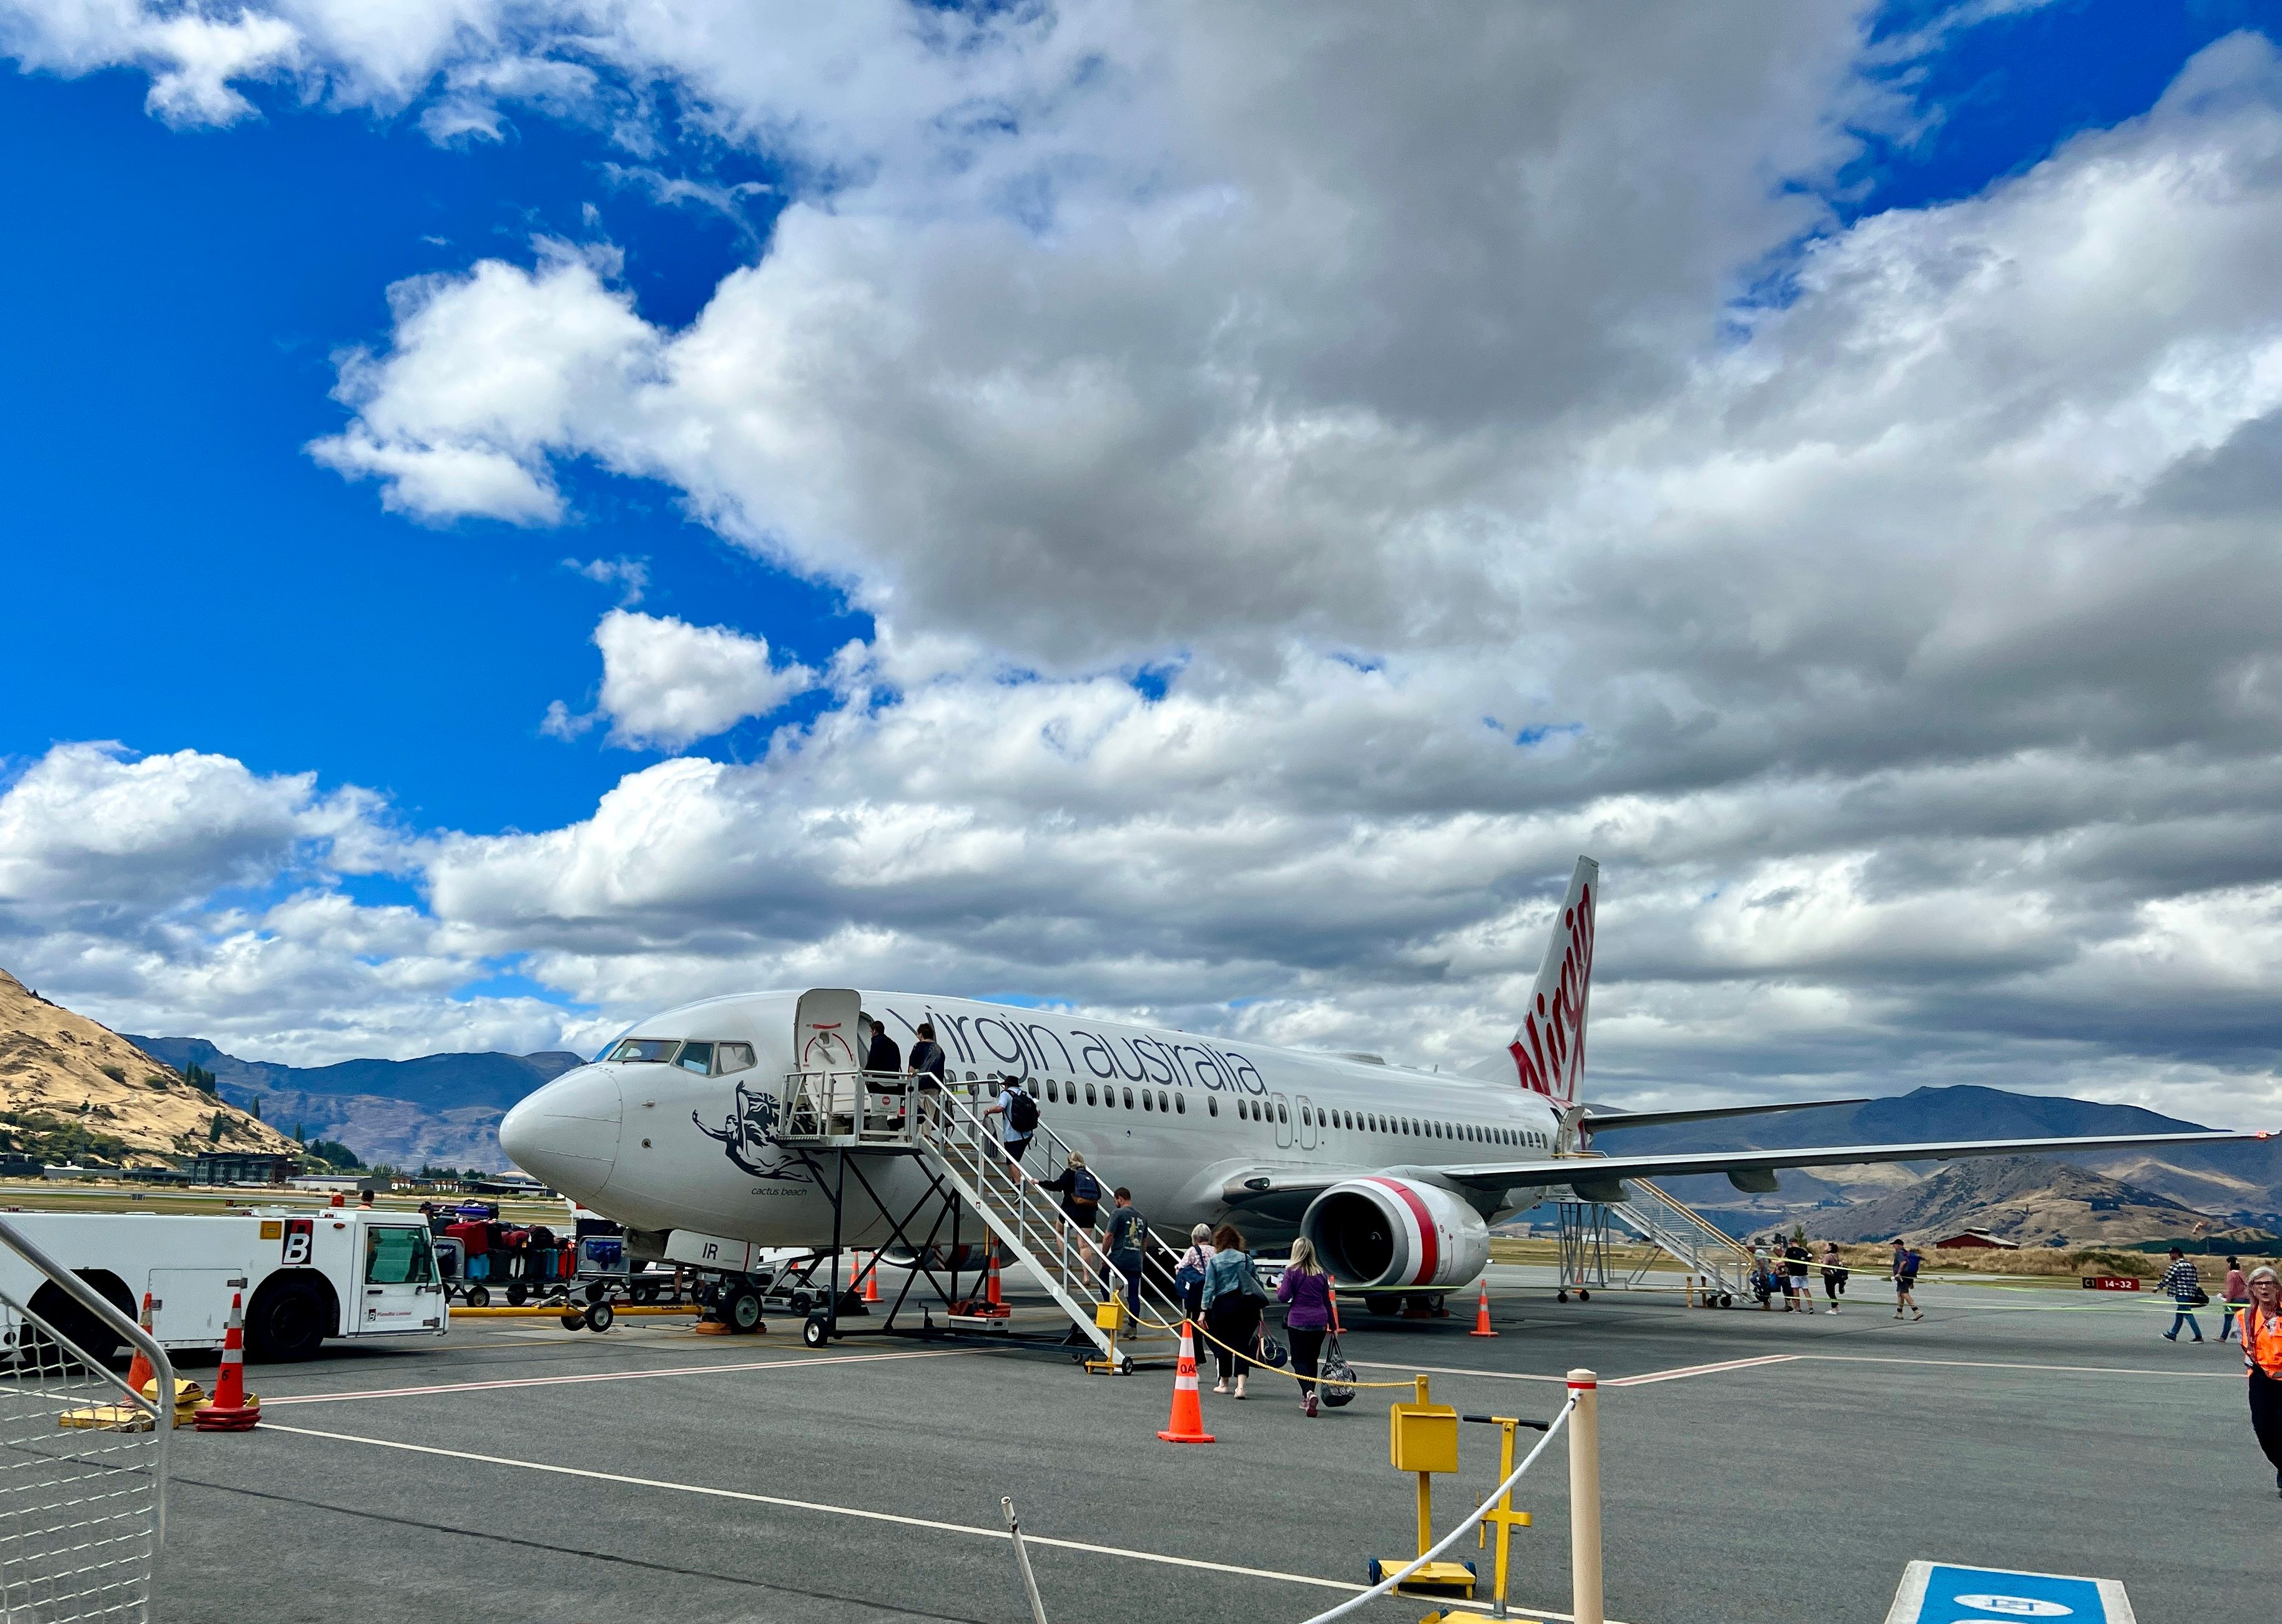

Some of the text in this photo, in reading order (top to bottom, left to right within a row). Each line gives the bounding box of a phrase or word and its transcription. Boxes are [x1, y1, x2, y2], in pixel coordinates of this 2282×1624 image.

[885, 1005, 1268, 1096] virgin australia
[780, 1188, 807, 1196] beach
[702, 1243, 718, 1259] IR
[2105, 1280, 2132, 1289] 14-32
